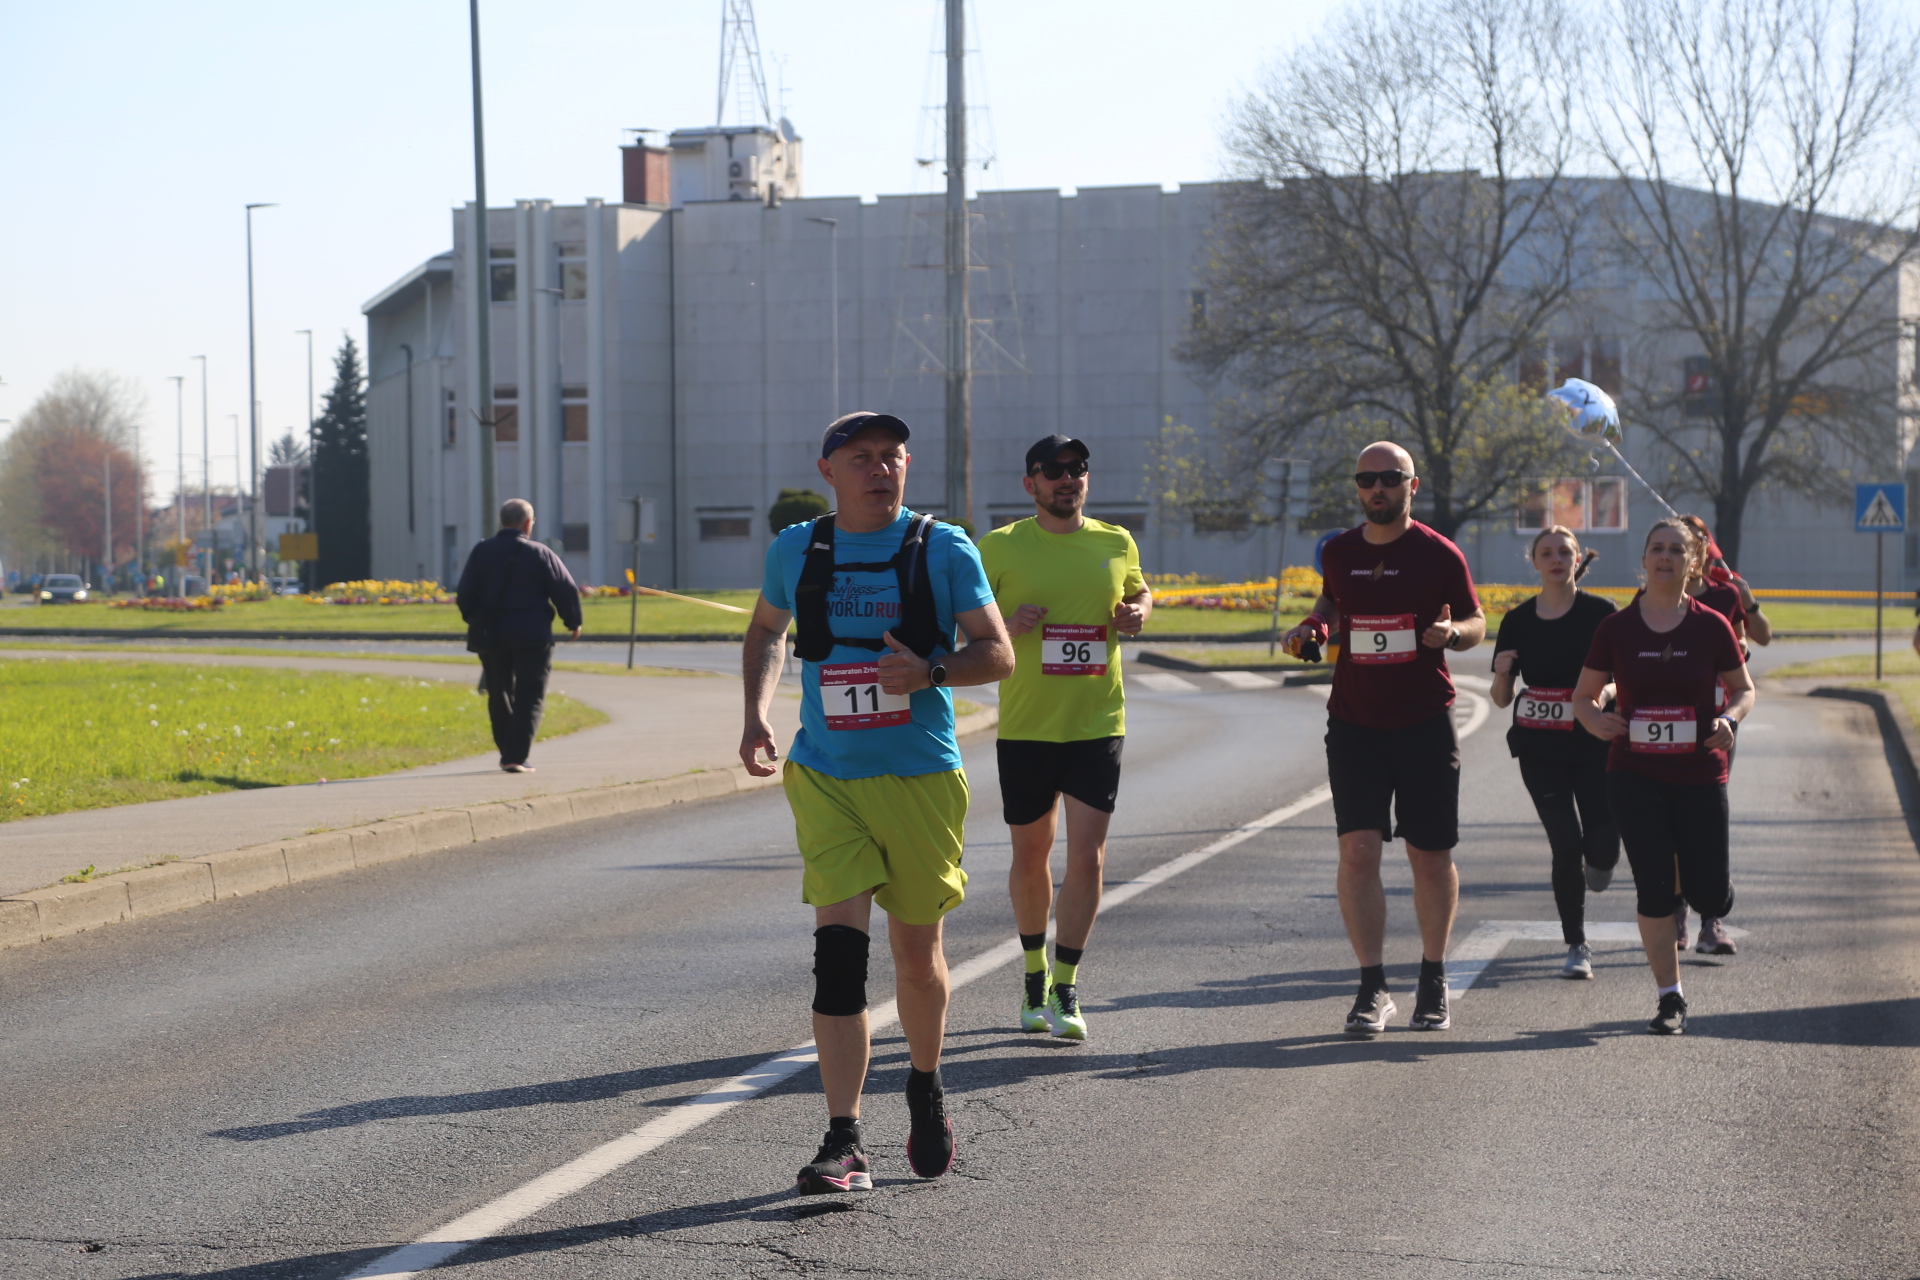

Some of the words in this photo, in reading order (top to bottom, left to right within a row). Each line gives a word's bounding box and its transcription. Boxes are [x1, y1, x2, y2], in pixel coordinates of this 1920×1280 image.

[827, 601, 874, 618] WORLD
[1373, 632, 1388, 653] 9
[1062, 642, 1091, 663] 96
[823, 668, 863, 676] Polumaraton
[844, 685, 879, 713] 11
[1524, 700, 1564, 719] 390
[1647, 722, 1674, 741] 91
